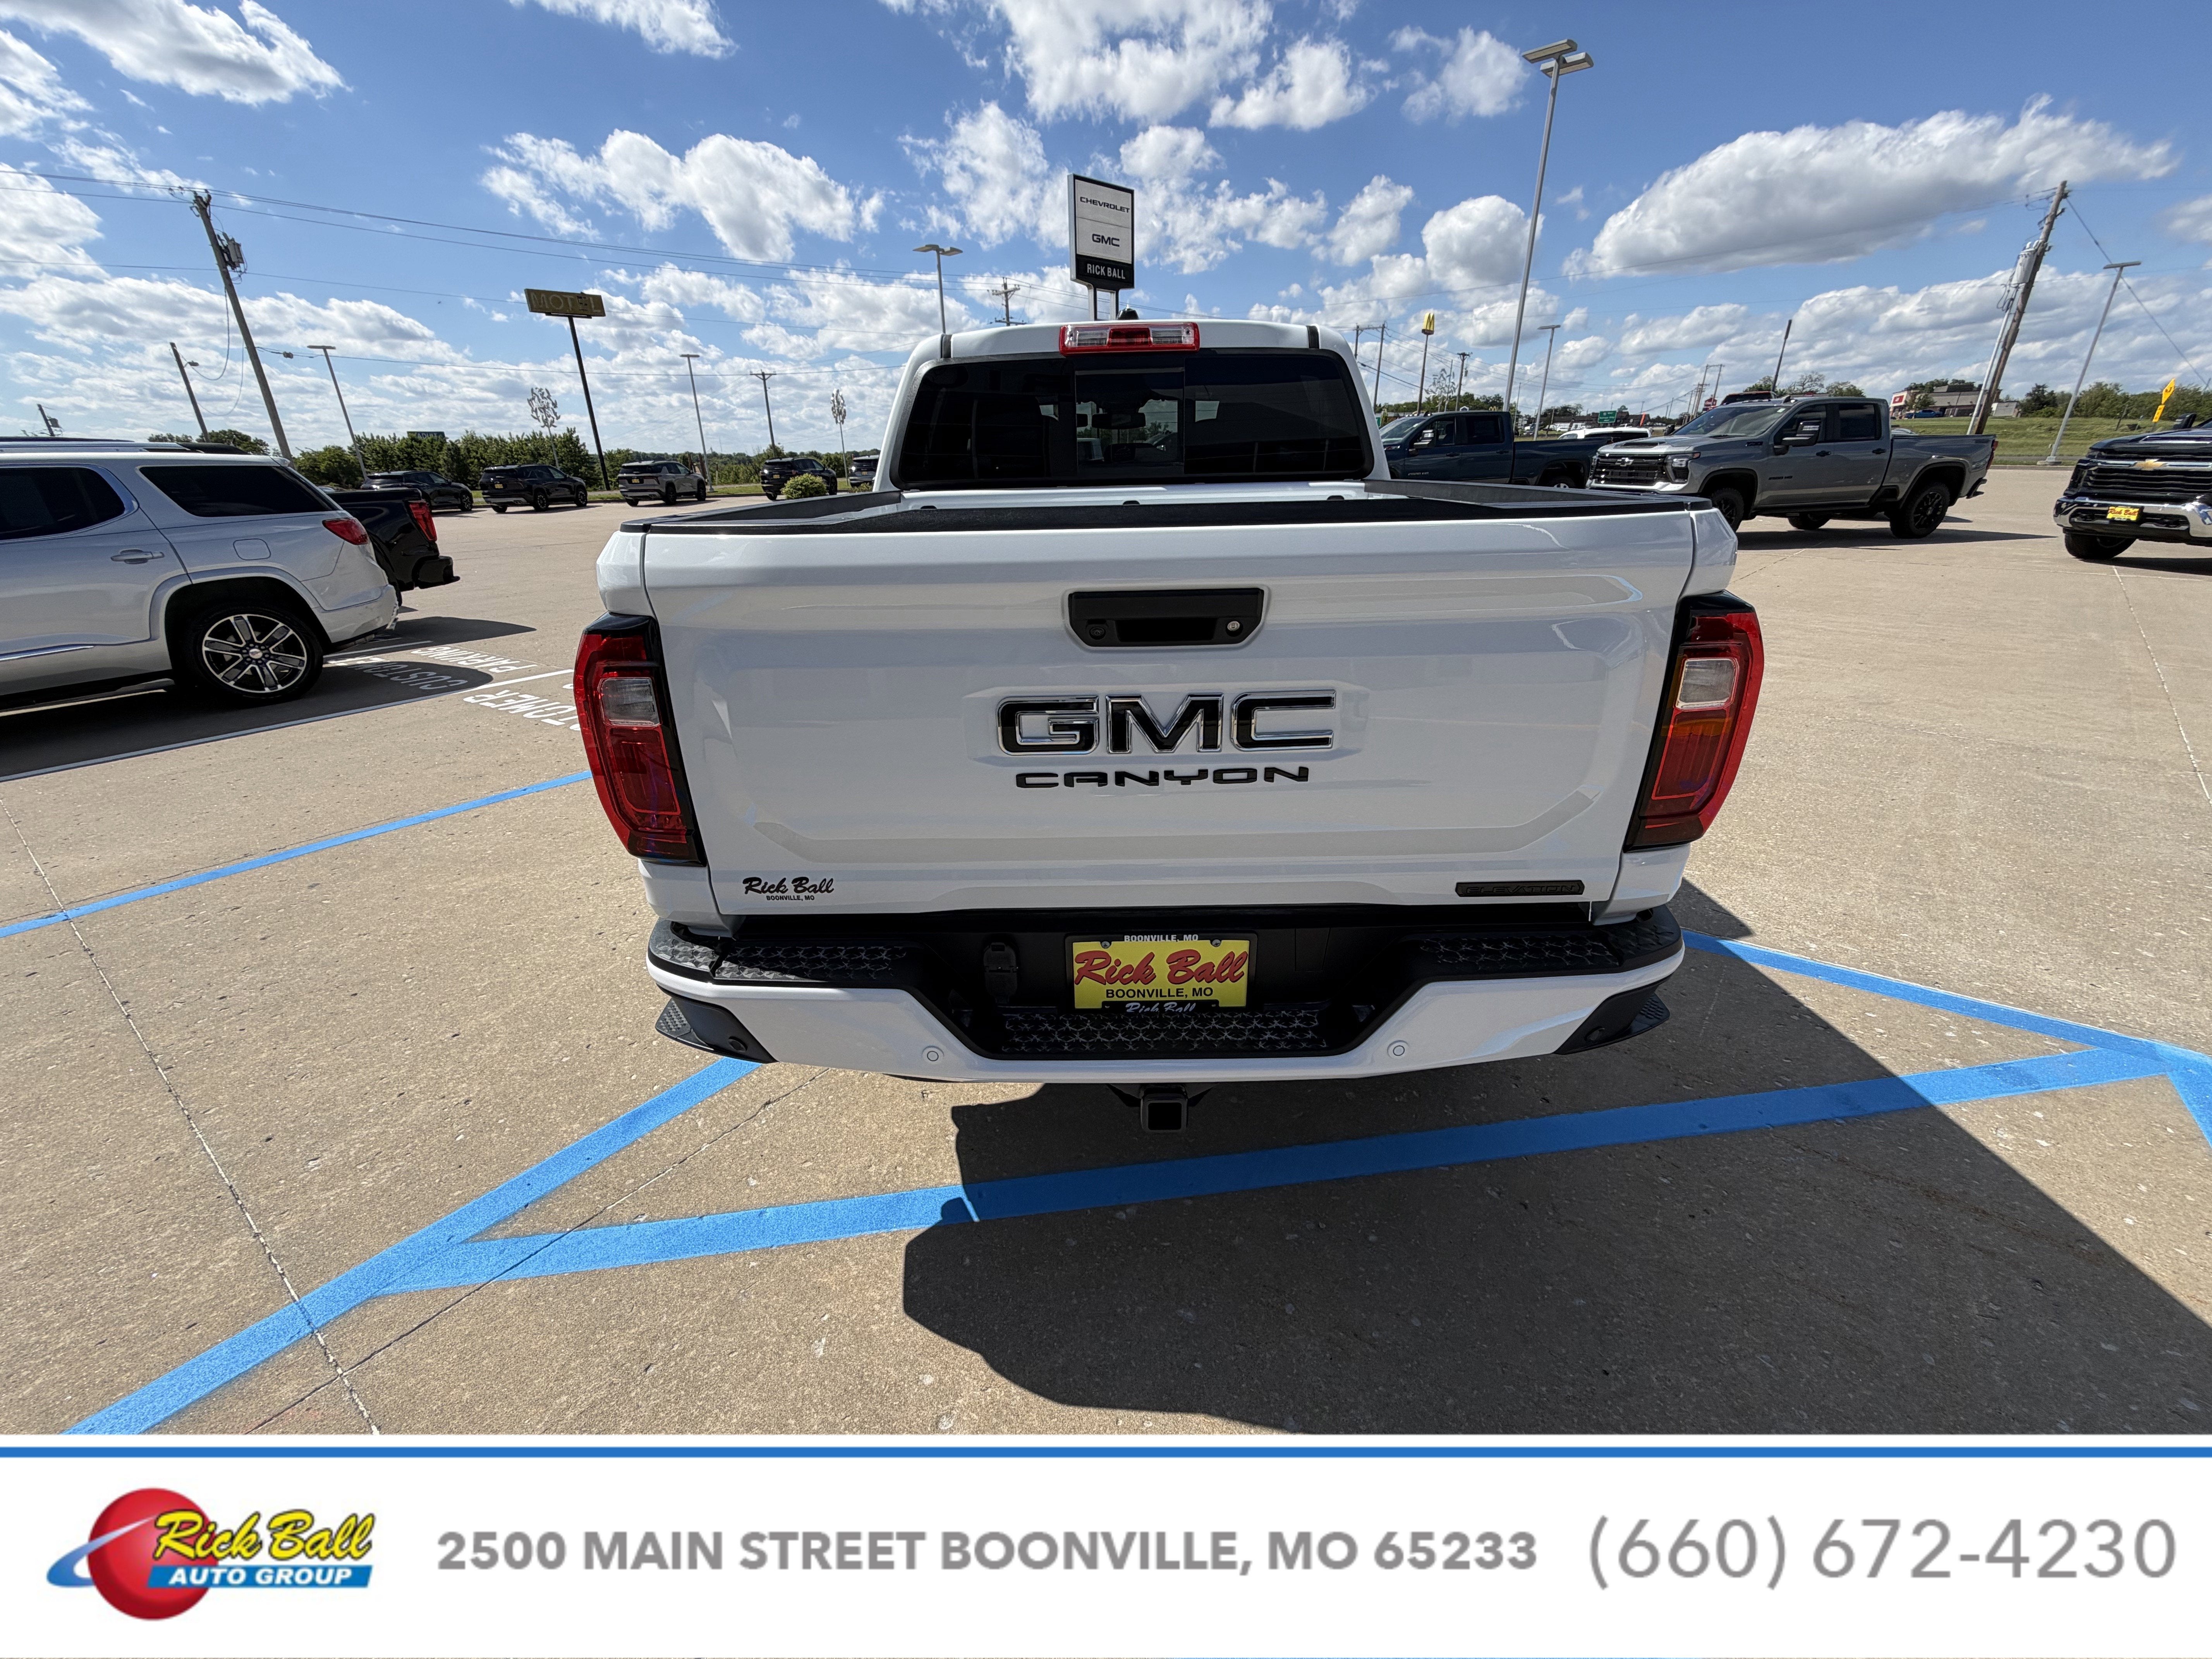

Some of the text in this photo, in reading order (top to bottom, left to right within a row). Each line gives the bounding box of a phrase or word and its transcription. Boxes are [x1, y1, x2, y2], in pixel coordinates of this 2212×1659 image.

[1080, 196, 1130, 213] CHEVROLET
[1092, 234, 1120, 247] GMC
[1087, 263, 1126, 280] RICK BALL
[530, 292, 601, 313] MOTEL
[410, 646, 538, 673] PARKING
[996, 689, 1337, 756] GMC
[1015, 766, 1309, 788] CANYON
[742, 877, 835, 895] Rick Ball
[1466, 885, 1576, 894] ELEVATION
[1074, 949, 1249, 986] Rick Ball
[1106, 987, 1213, 999] BOONVILLE, MO
